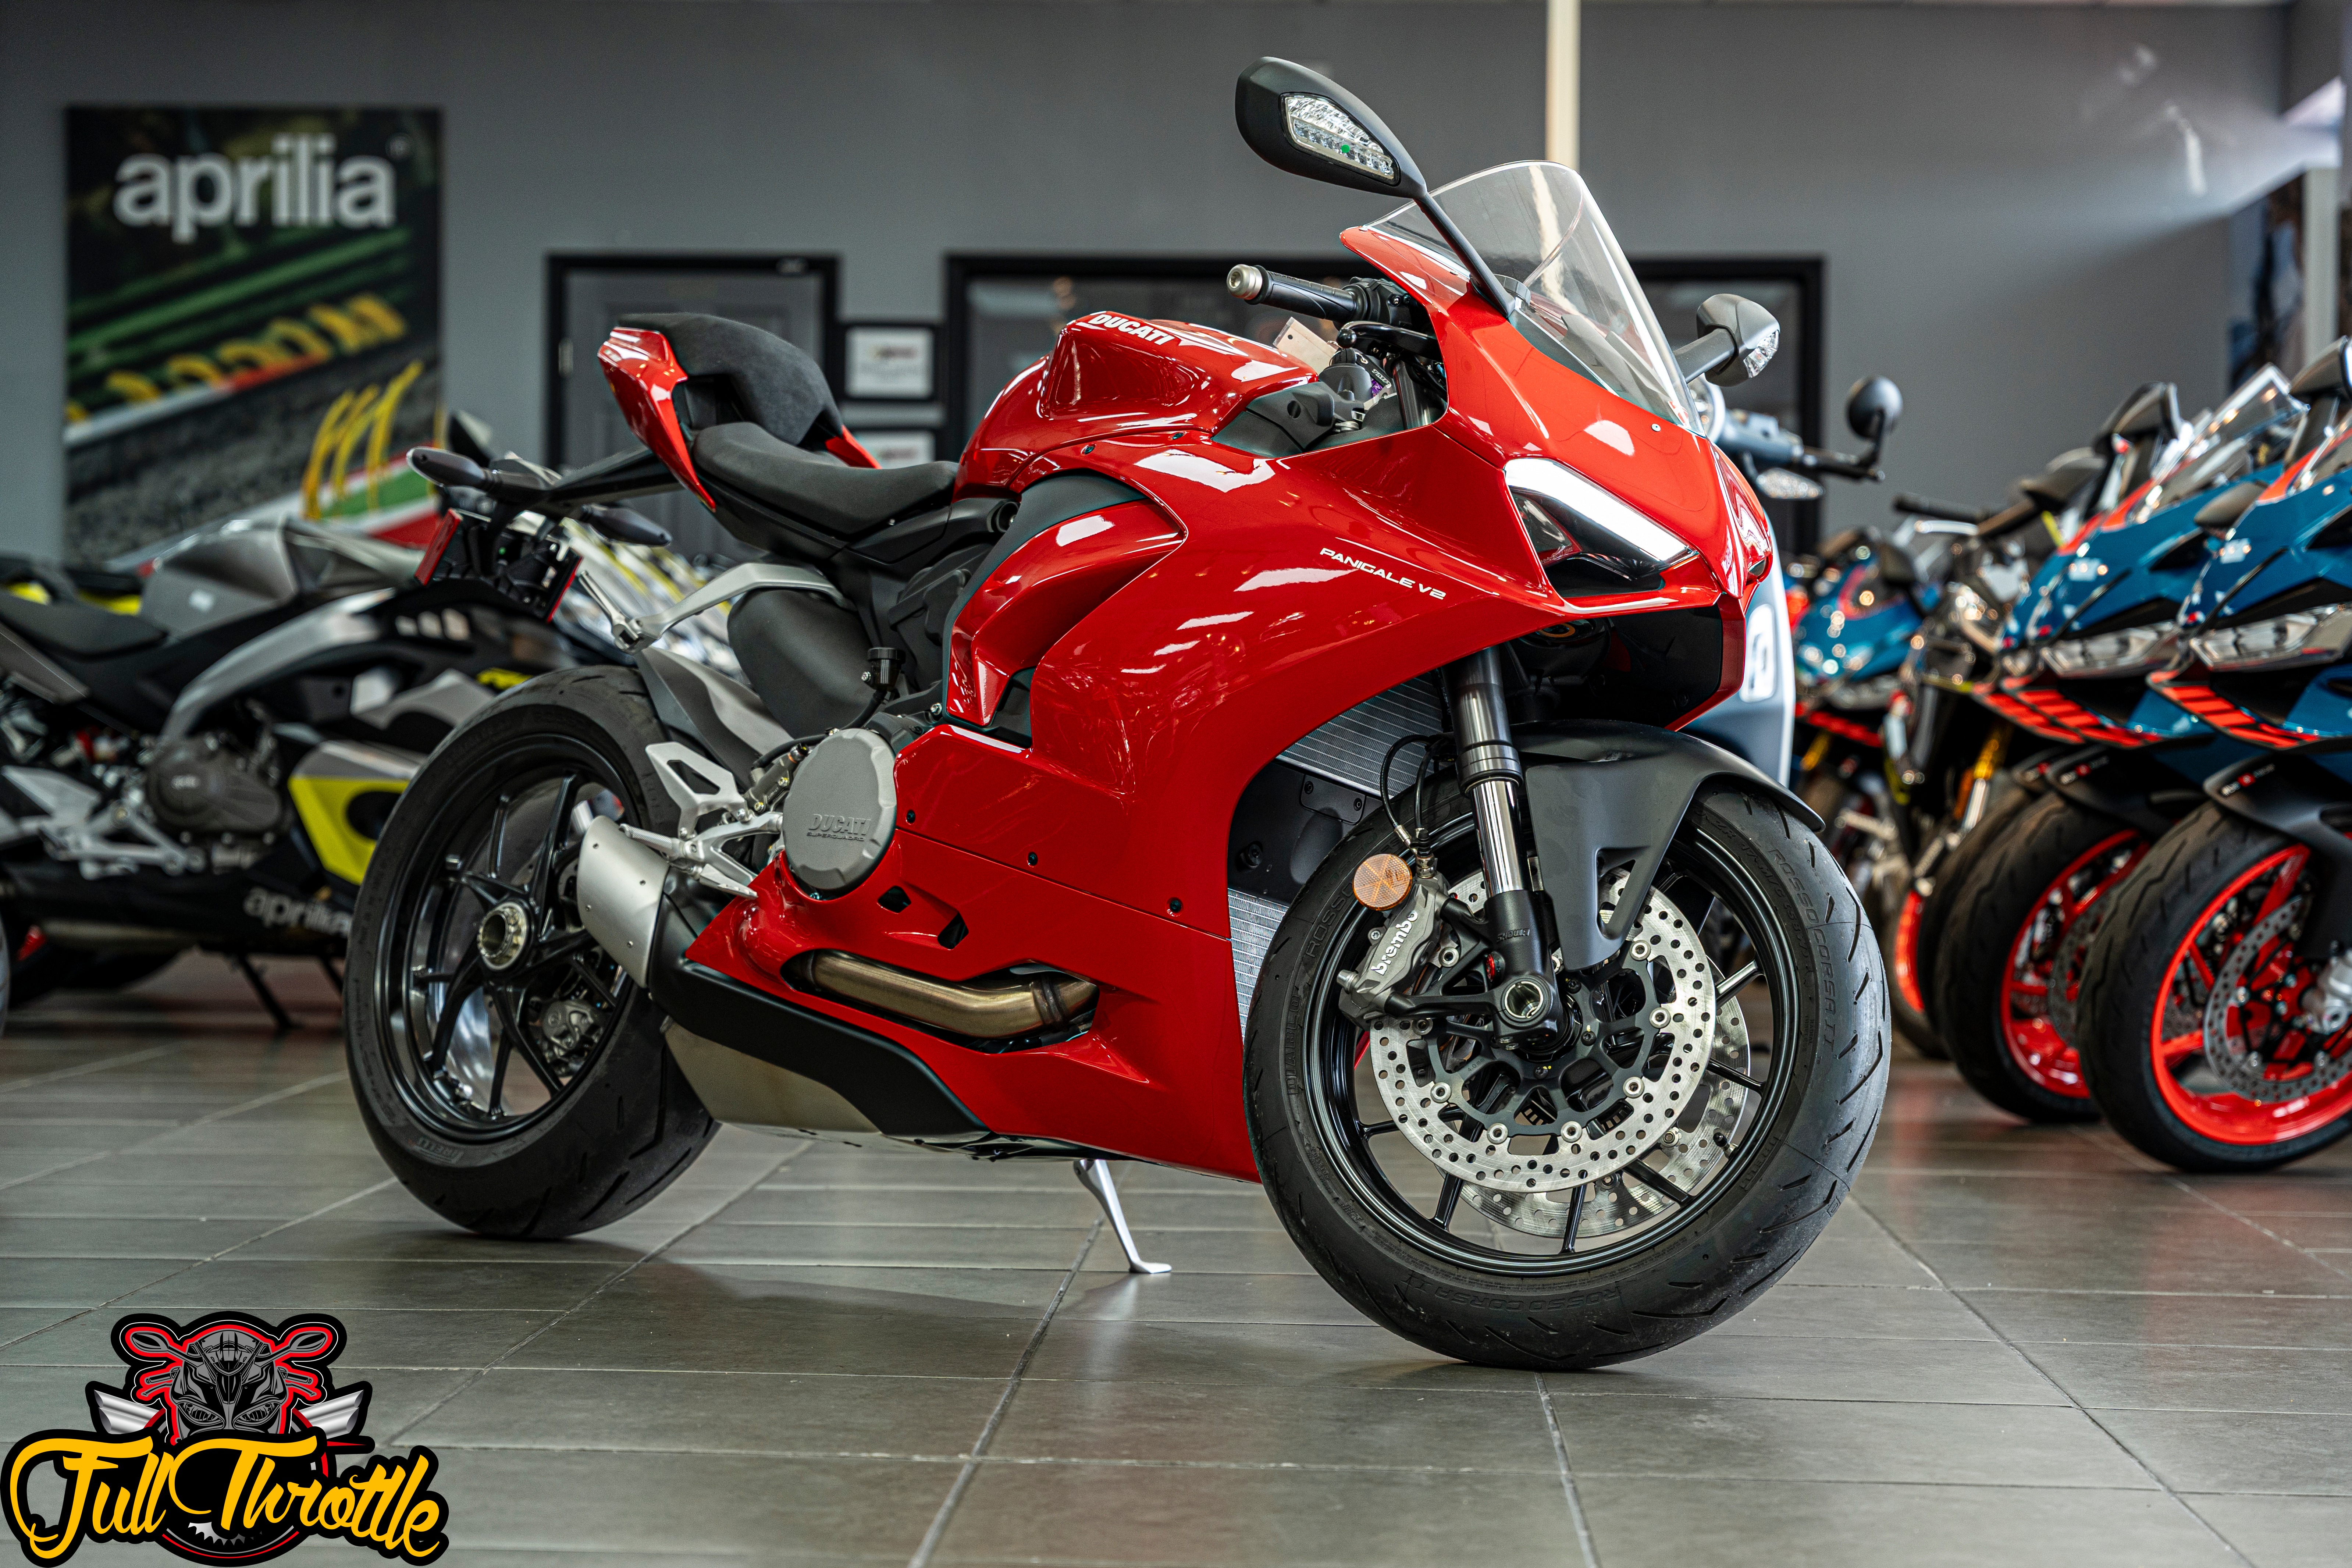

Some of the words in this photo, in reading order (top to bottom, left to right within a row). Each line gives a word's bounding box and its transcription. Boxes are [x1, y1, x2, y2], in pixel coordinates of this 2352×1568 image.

[113, 133, 398, 243] aprilia
[1089, 314, 1175, 346] DUCATI
[1319, 547, 1416, 589] PANIGALE
[1419, 583, 1447, 600] V2
[807, 832, 865, 842] SUPERQUADRO
[808, 814, 871, 836] DUCATI
[1370, 910, 1419, 975] brembo
[1497, 928, 1530, 943] SHOWA
[1766, 845, 1821, 927] ROSSO
[1810, 925, 1837, 1017] CORSA
[1284, 994, 1303, 1096] DIABLO
[1433, 1284, 1524, 1314] CORSA
[1528, 1286, 1620, 1312] ROSSO
